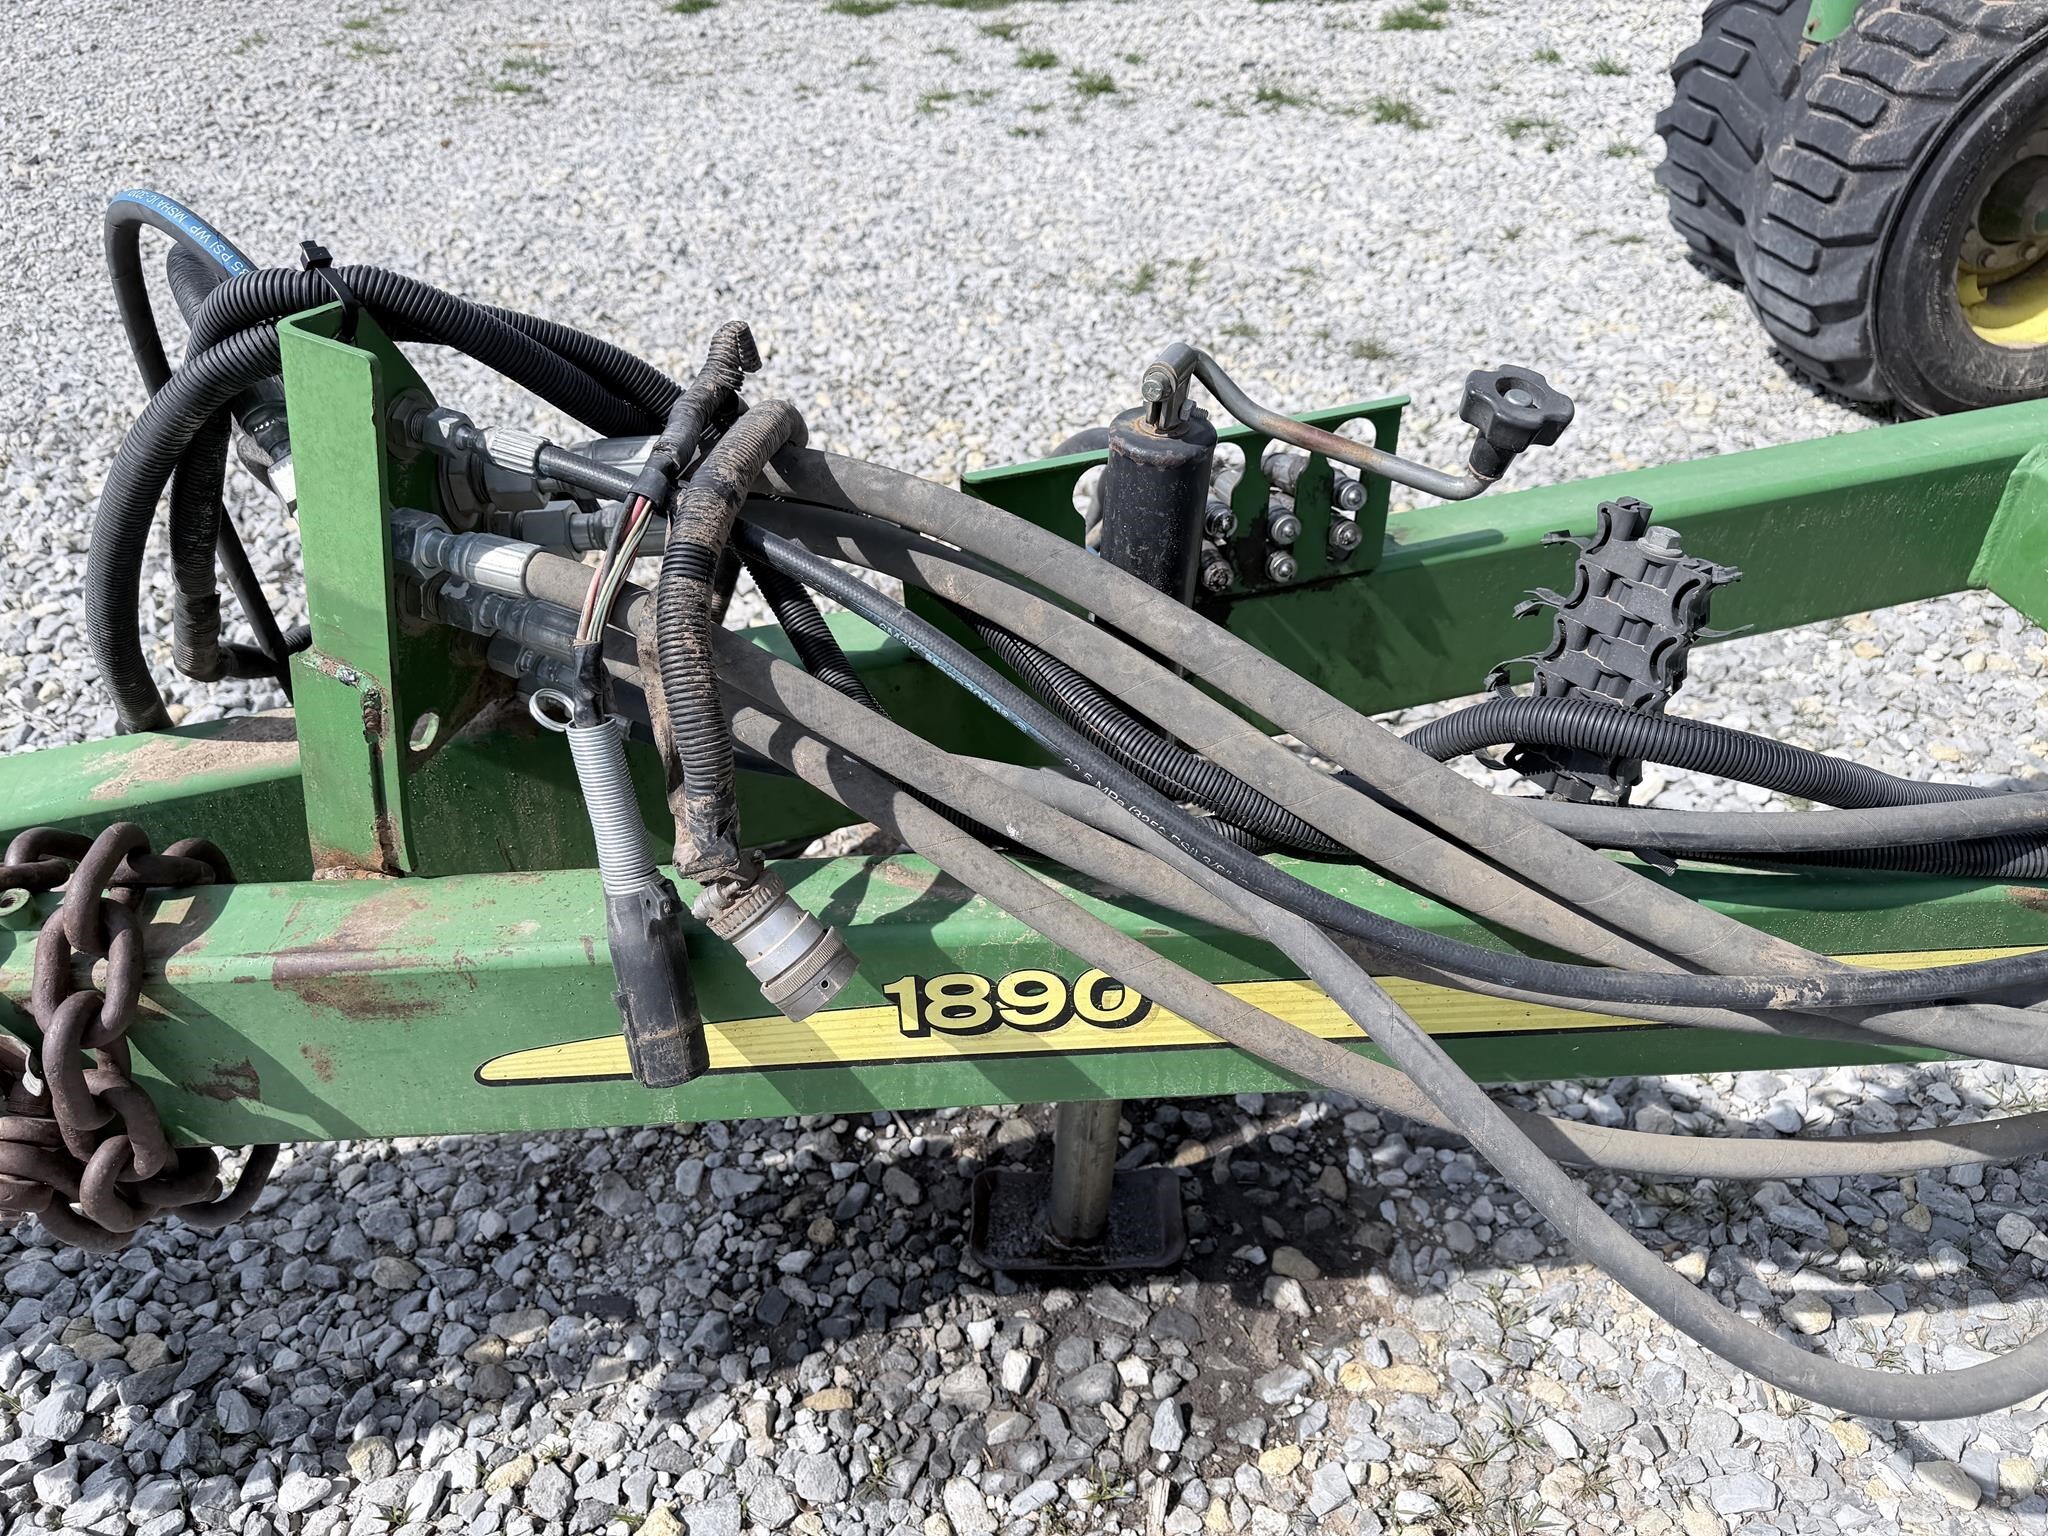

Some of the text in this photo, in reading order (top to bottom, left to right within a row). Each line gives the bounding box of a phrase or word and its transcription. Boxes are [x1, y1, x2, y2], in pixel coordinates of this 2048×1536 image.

[157, 201, 188, 223] MSHA
[190, 225, 212, 243] WP
[210, 241, 233, 262] PSI
[882, 968, 1152, 1037] 1890
